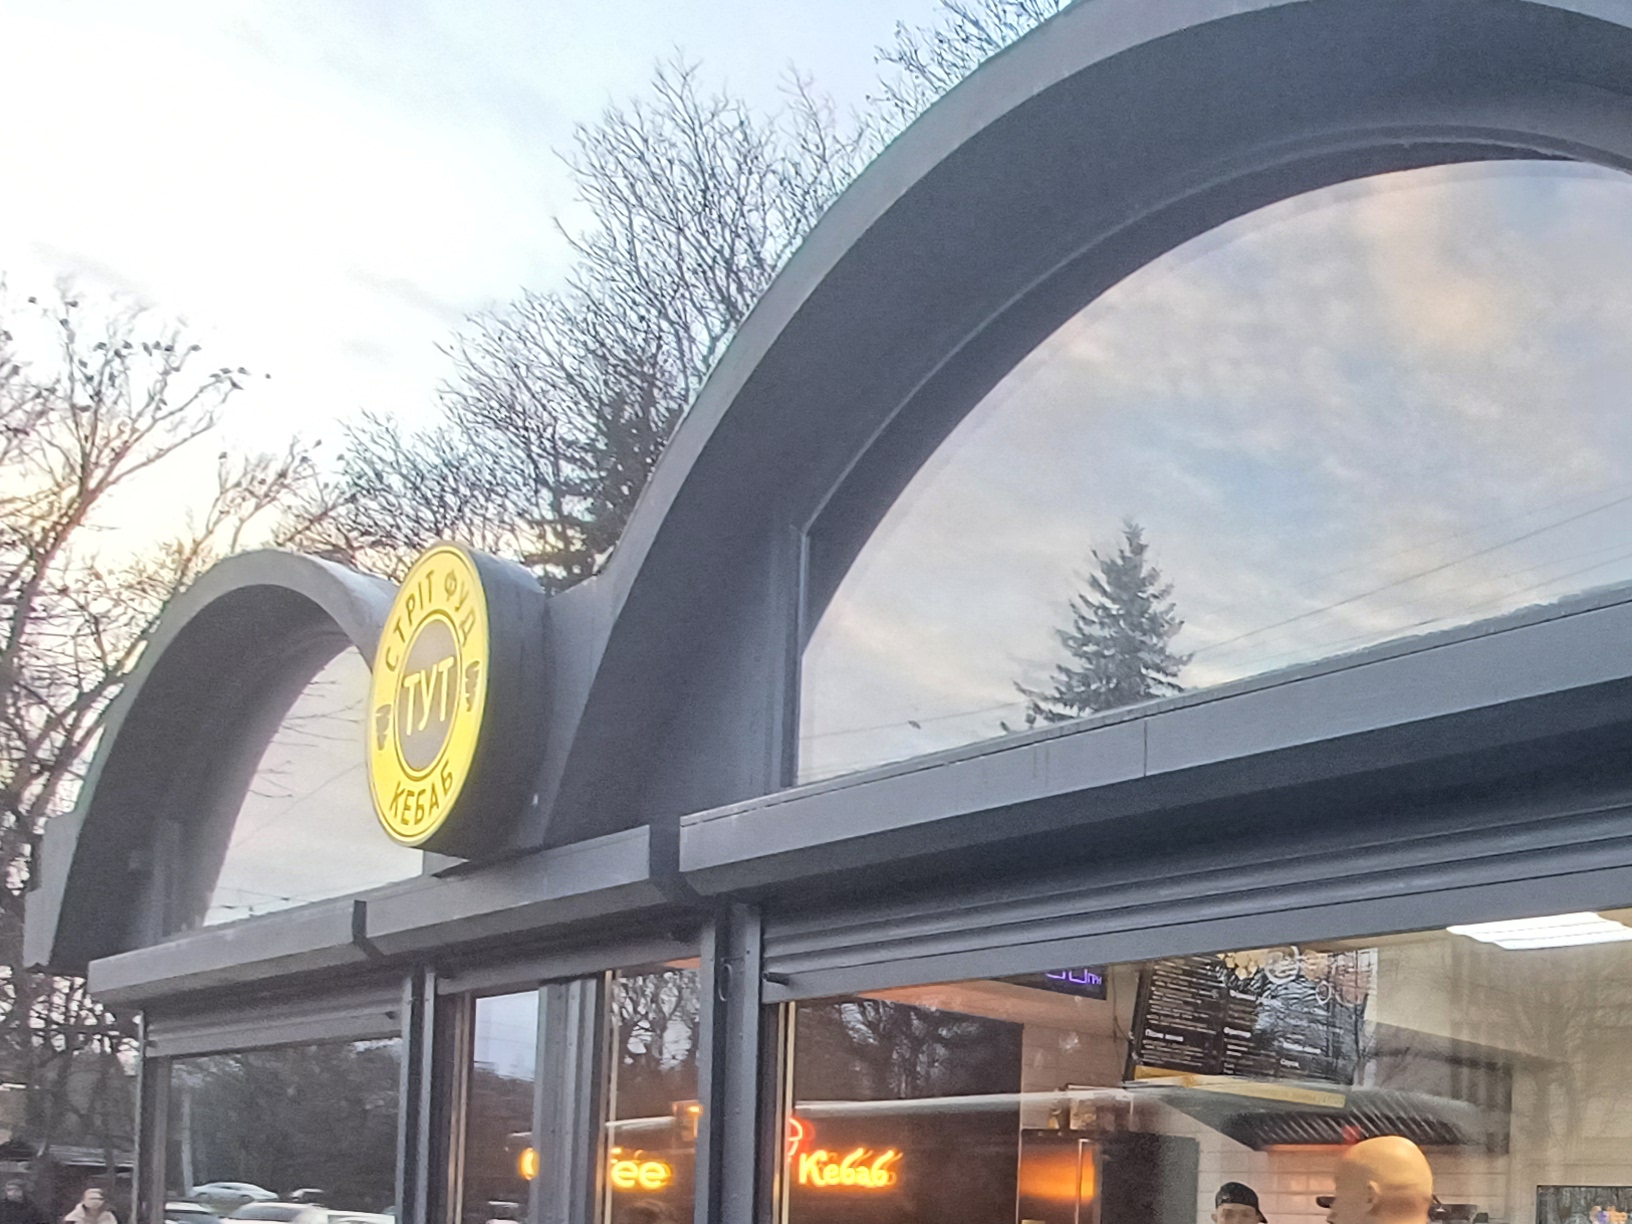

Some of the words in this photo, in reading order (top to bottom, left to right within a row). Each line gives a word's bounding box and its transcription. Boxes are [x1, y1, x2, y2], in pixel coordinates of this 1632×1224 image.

[385, 568, 435, 673] СТРІТ
[443, 569, 477, 649] ФУД
[402, 656, 455, 737] ТУТ
[388, 759, 454, 826] КЕБАБ
[798, 1147, 897, 1188] Kebab
